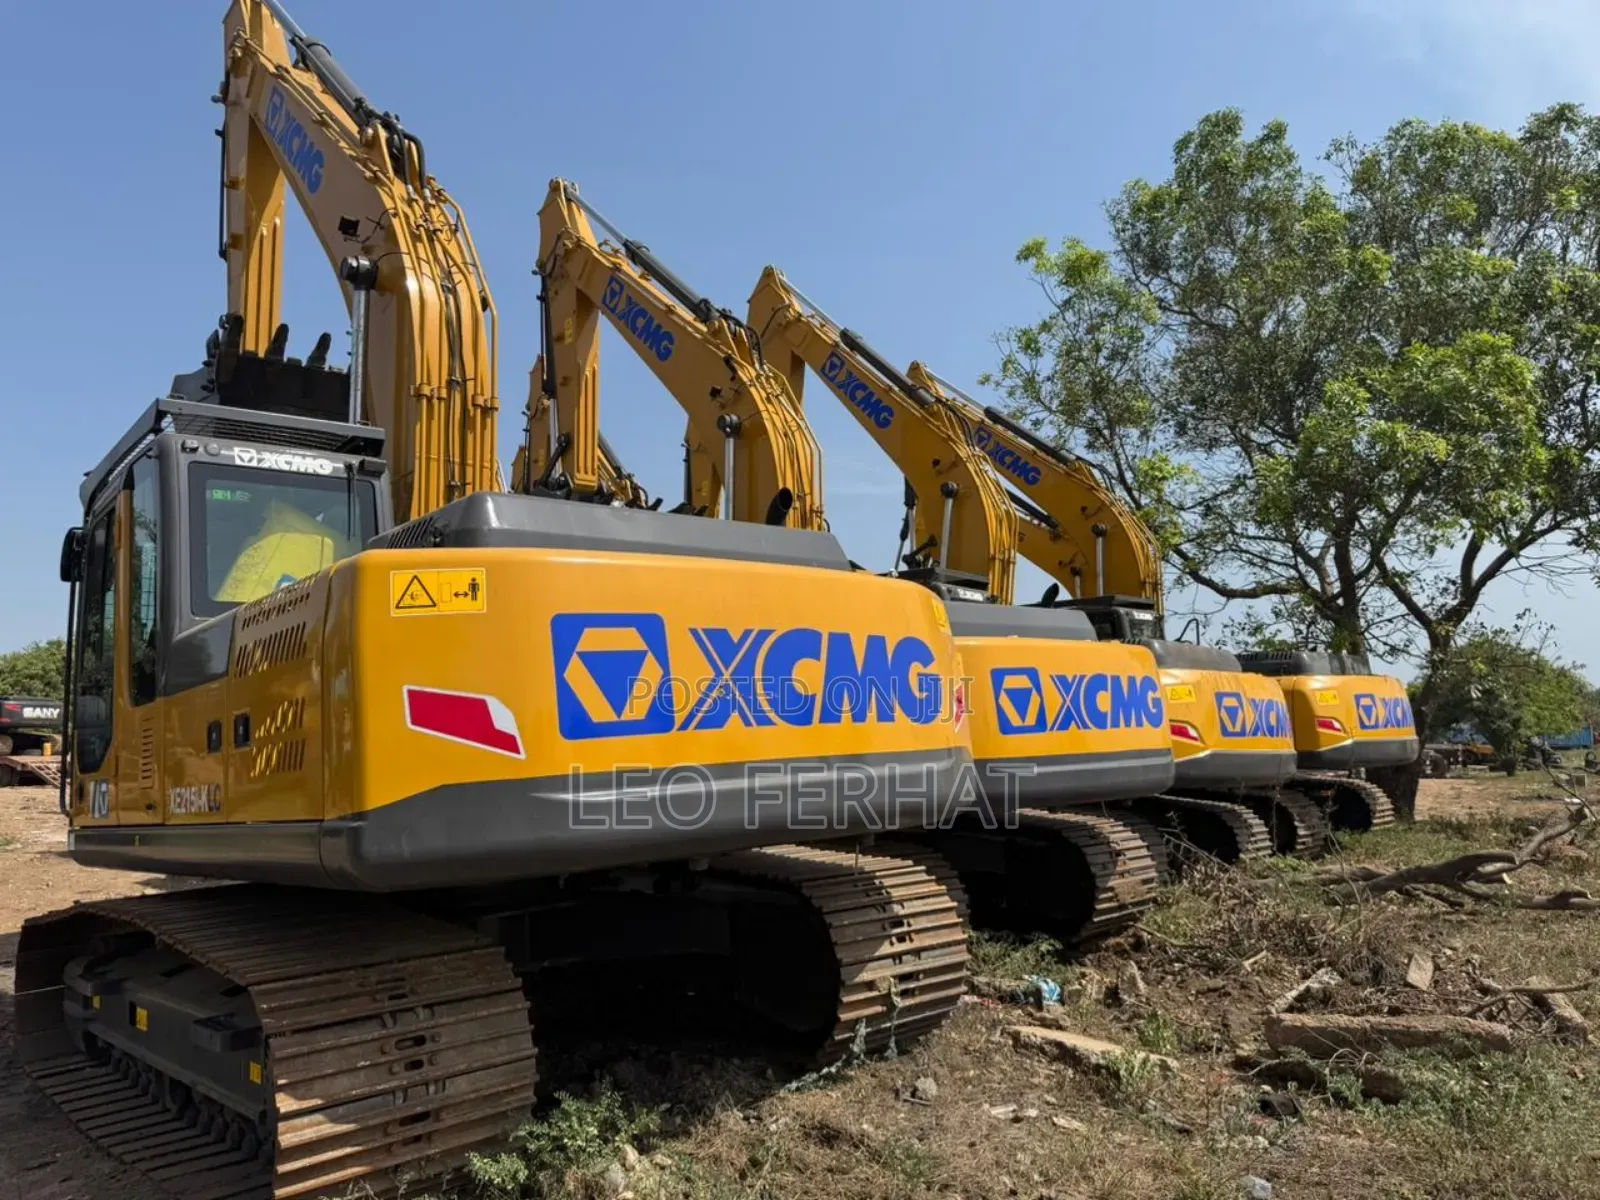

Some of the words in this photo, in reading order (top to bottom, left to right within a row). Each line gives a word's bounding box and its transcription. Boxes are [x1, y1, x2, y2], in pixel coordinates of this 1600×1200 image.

[276, 108, 325, 195] XCMG
[619, 294, 675, 362] XCMG
[835, 369, 895, 430] XCMG
[257, 451, 334, 475] XCMG
[986, 442, 1042, 486] XCMG
[678, 627, 943, 731] XCMG
[1048, 673, 1164, 731] XCMG
